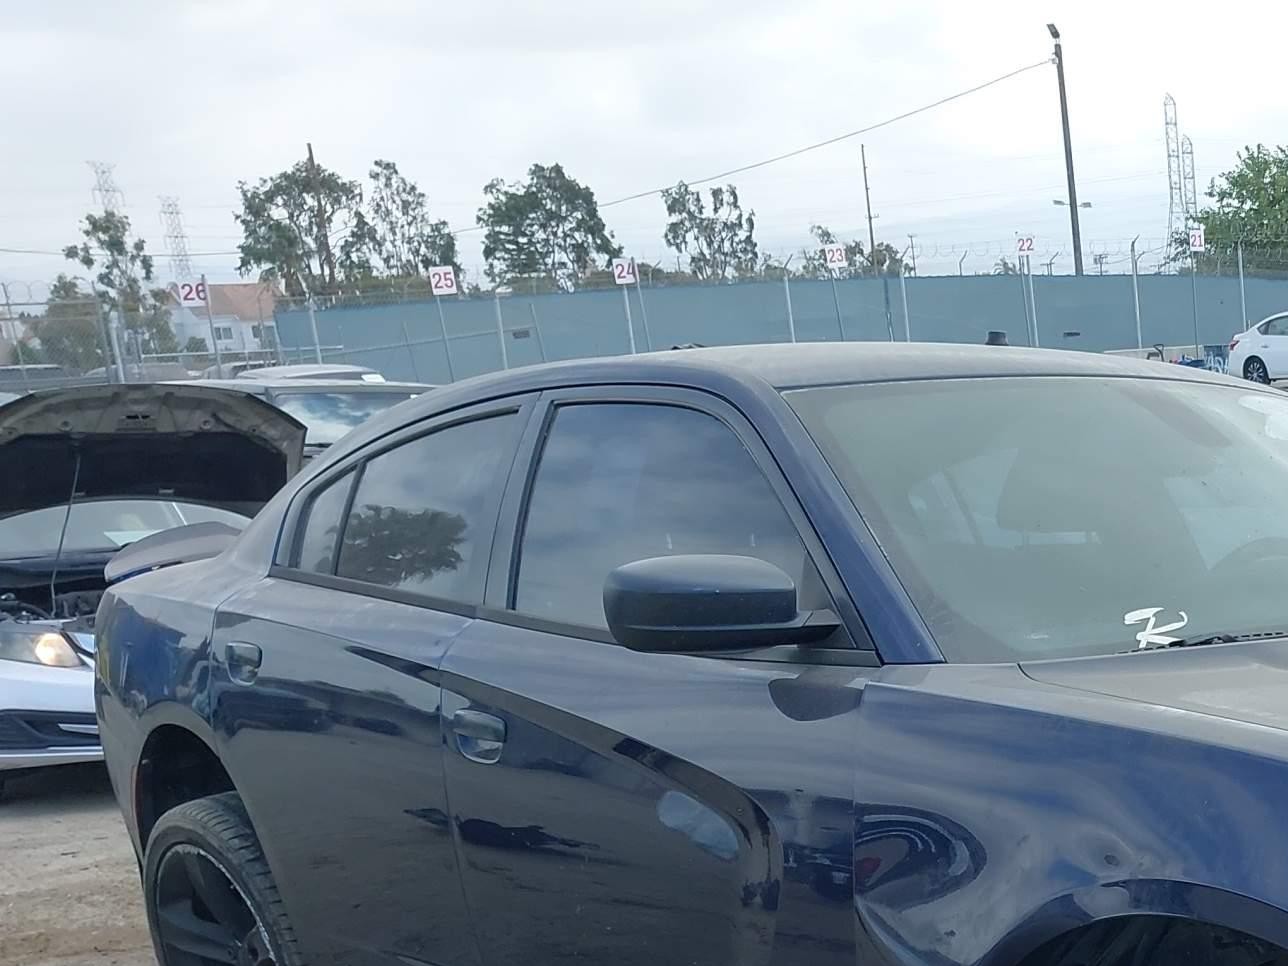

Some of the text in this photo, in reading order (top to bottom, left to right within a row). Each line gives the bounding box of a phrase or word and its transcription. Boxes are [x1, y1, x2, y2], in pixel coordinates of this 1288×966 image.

[1017, 238, 1034, 251] 22
[1190, 234, 1203, 247] 21
[827, 247, 844, 263] 23
[615, 262, 636, 279] 24
[432, 271, 454, 289] 25
[180, 282, 207, 301] 26
